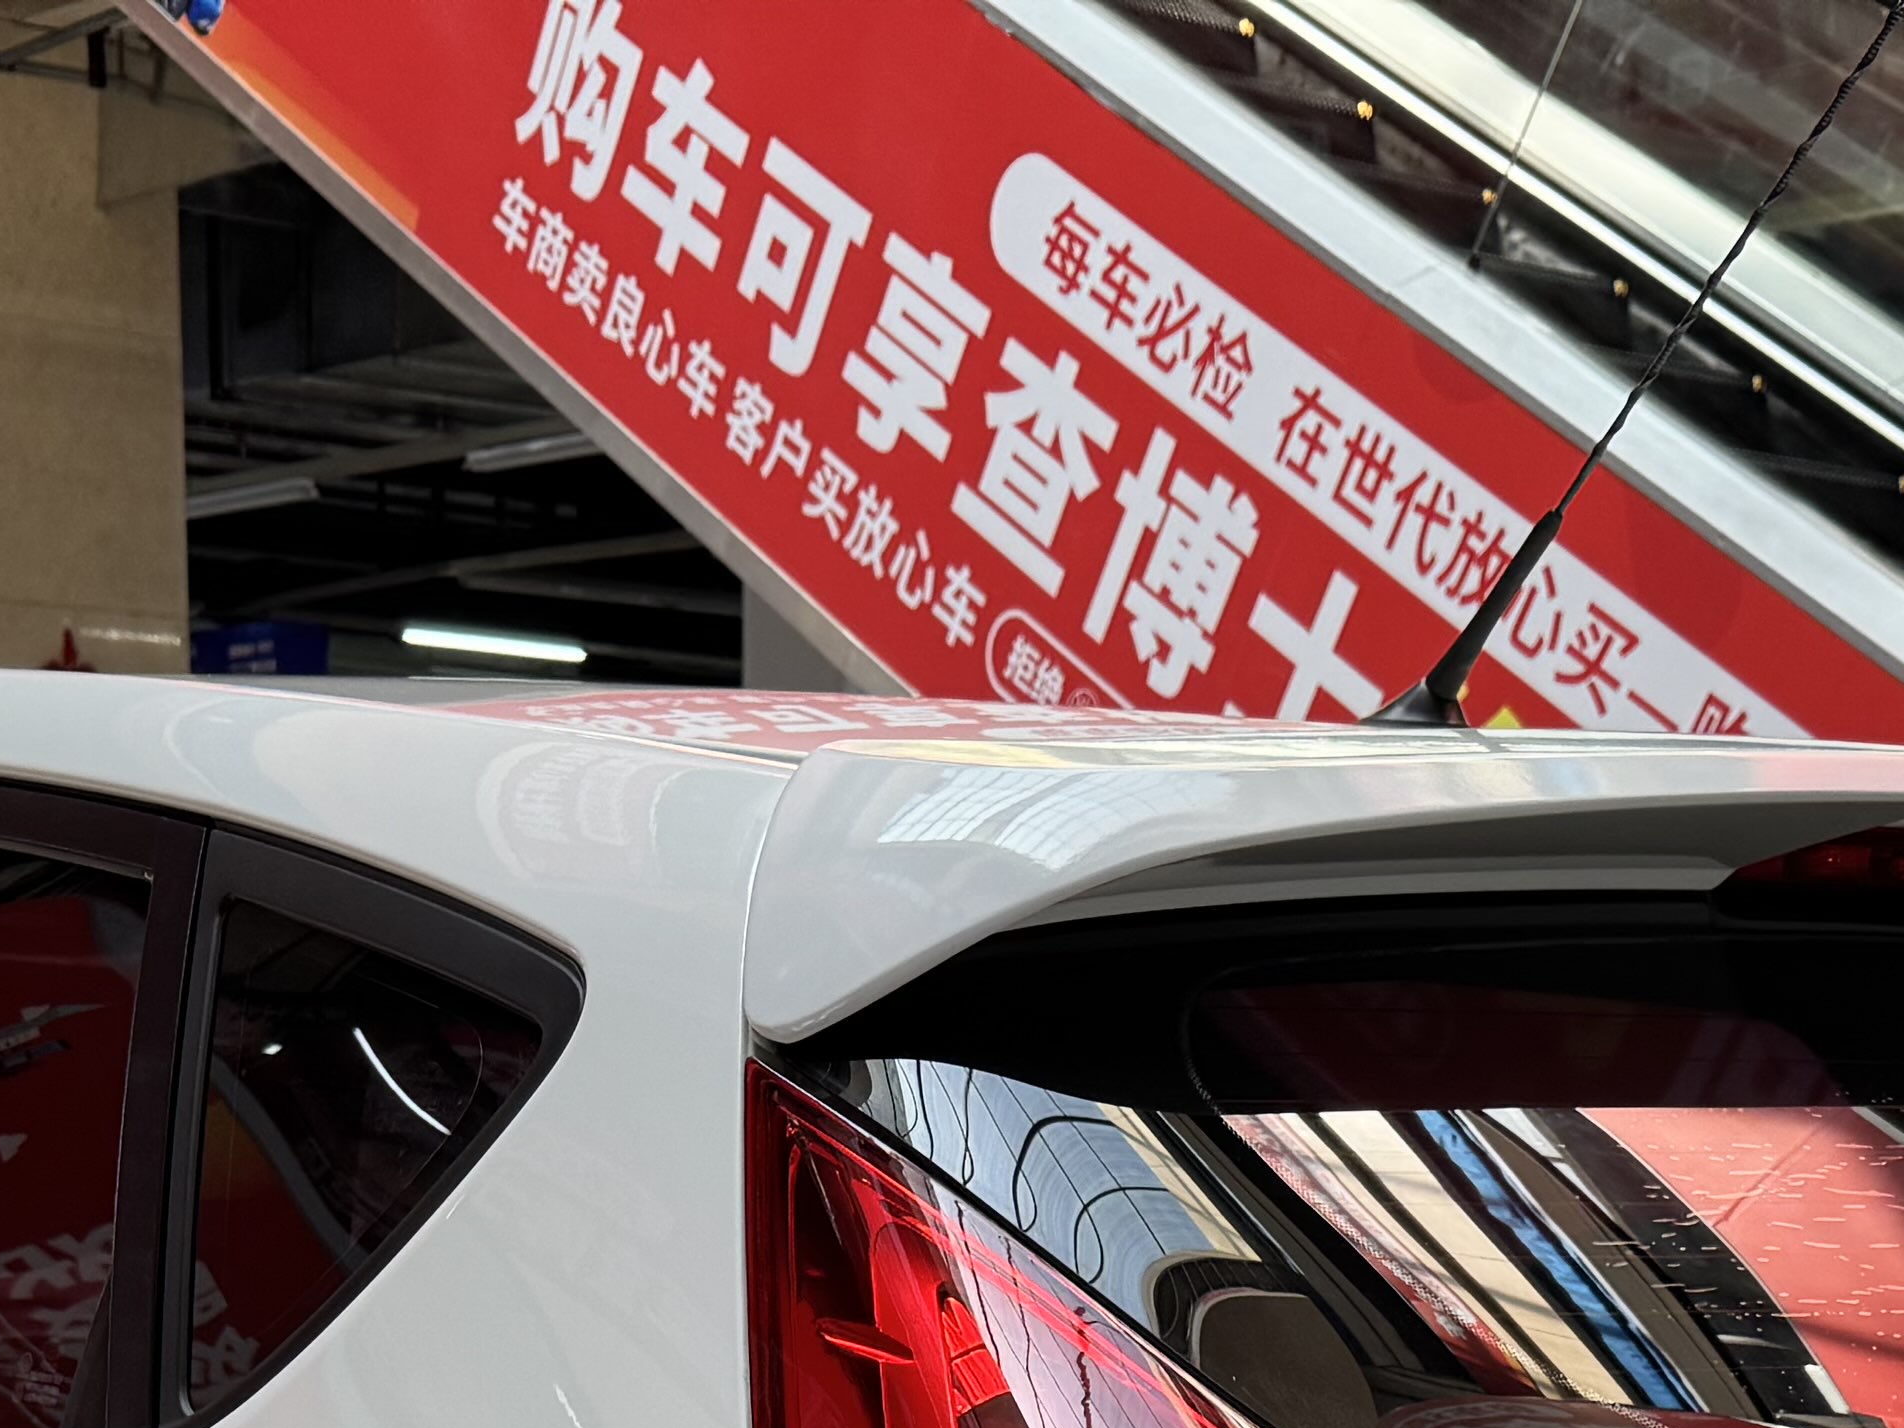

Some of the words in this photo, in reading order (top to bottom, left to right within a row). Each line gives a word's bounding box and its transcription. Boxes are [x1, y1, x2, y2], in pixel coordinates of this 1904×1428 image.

[492, 178, 725, 420] 车商卖良心车
[725, 377, 987, 647] 客户买放心车
[514, 0, 1386, 722] 购车可享查博士
[1041, 197, 1255, 423] 每车必检
[1002, 633, 1065, 704] 拒绝
